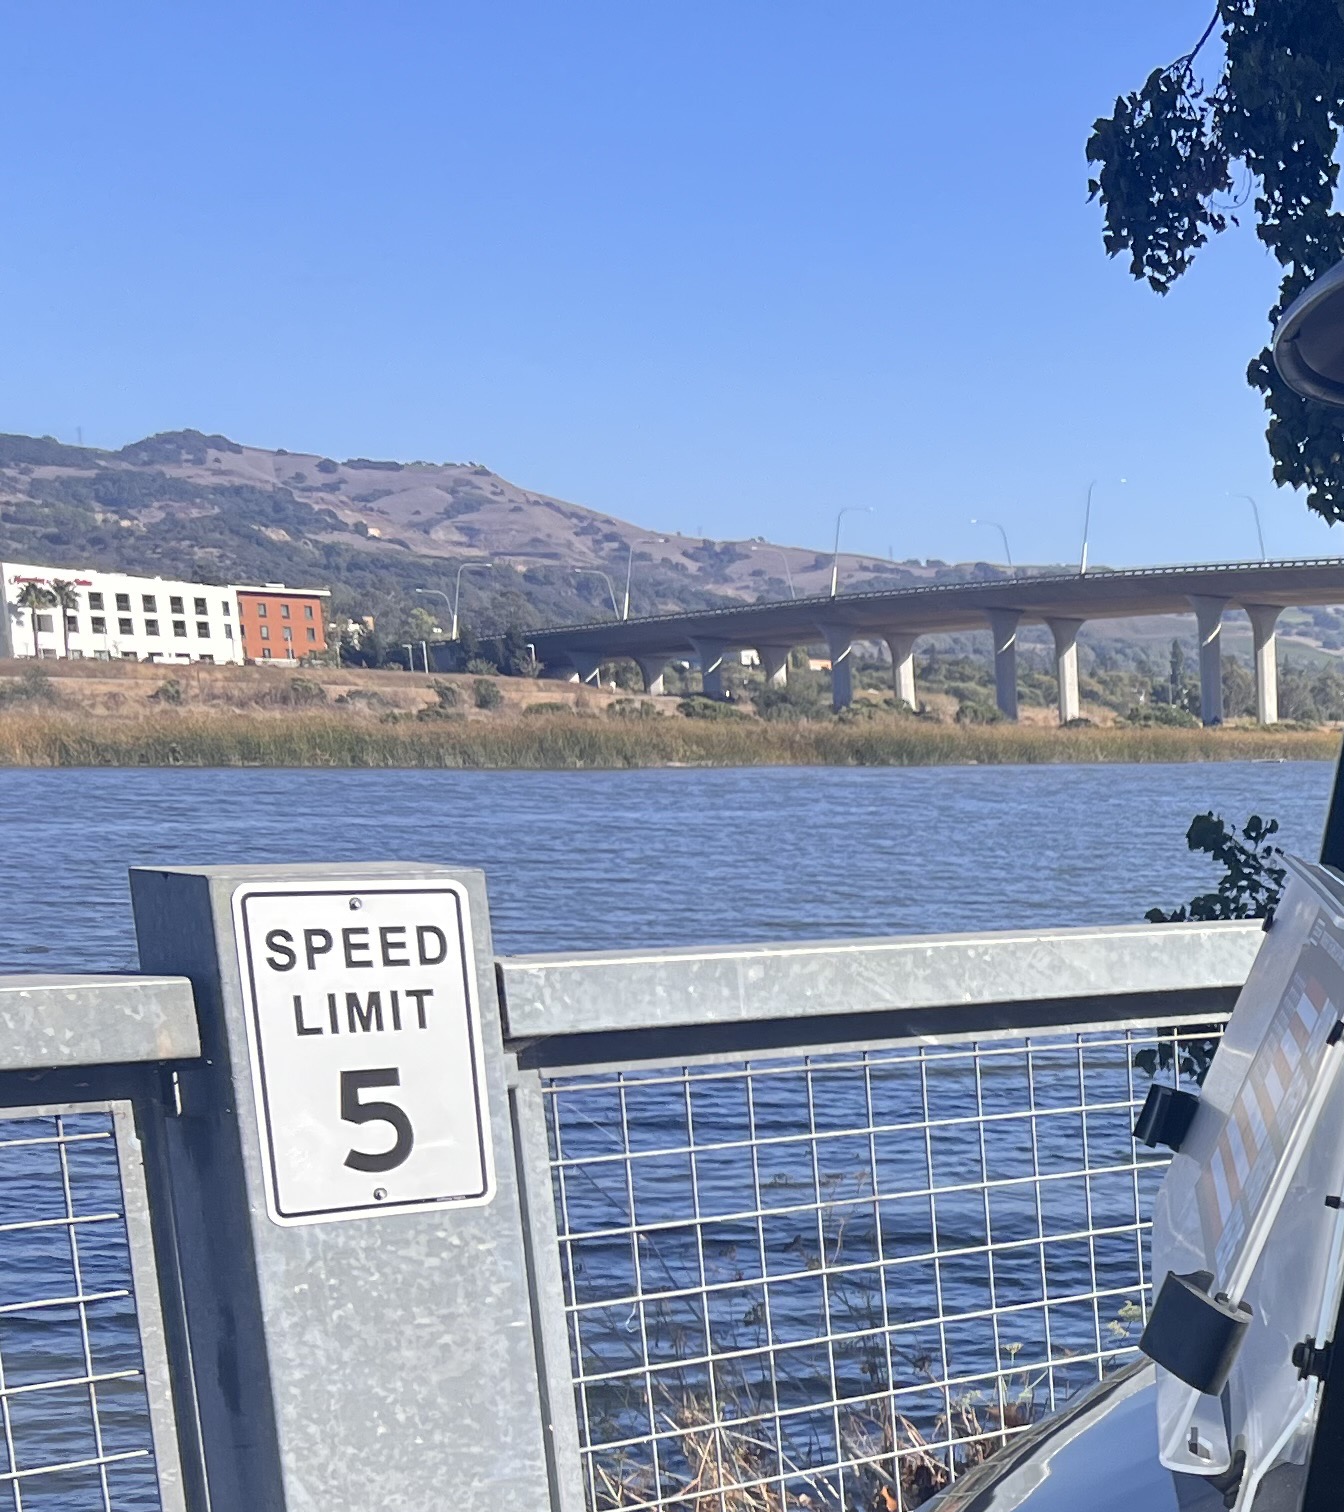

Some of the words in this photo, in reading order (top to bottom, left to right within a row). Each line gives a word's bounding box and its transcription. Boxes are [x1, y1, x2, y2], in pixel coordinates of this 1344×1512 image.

[265, 925, 448, 972] SPEED
[293, 989, 434, 1036] LIMIT
[340, 1067, 414, 1173] 5
